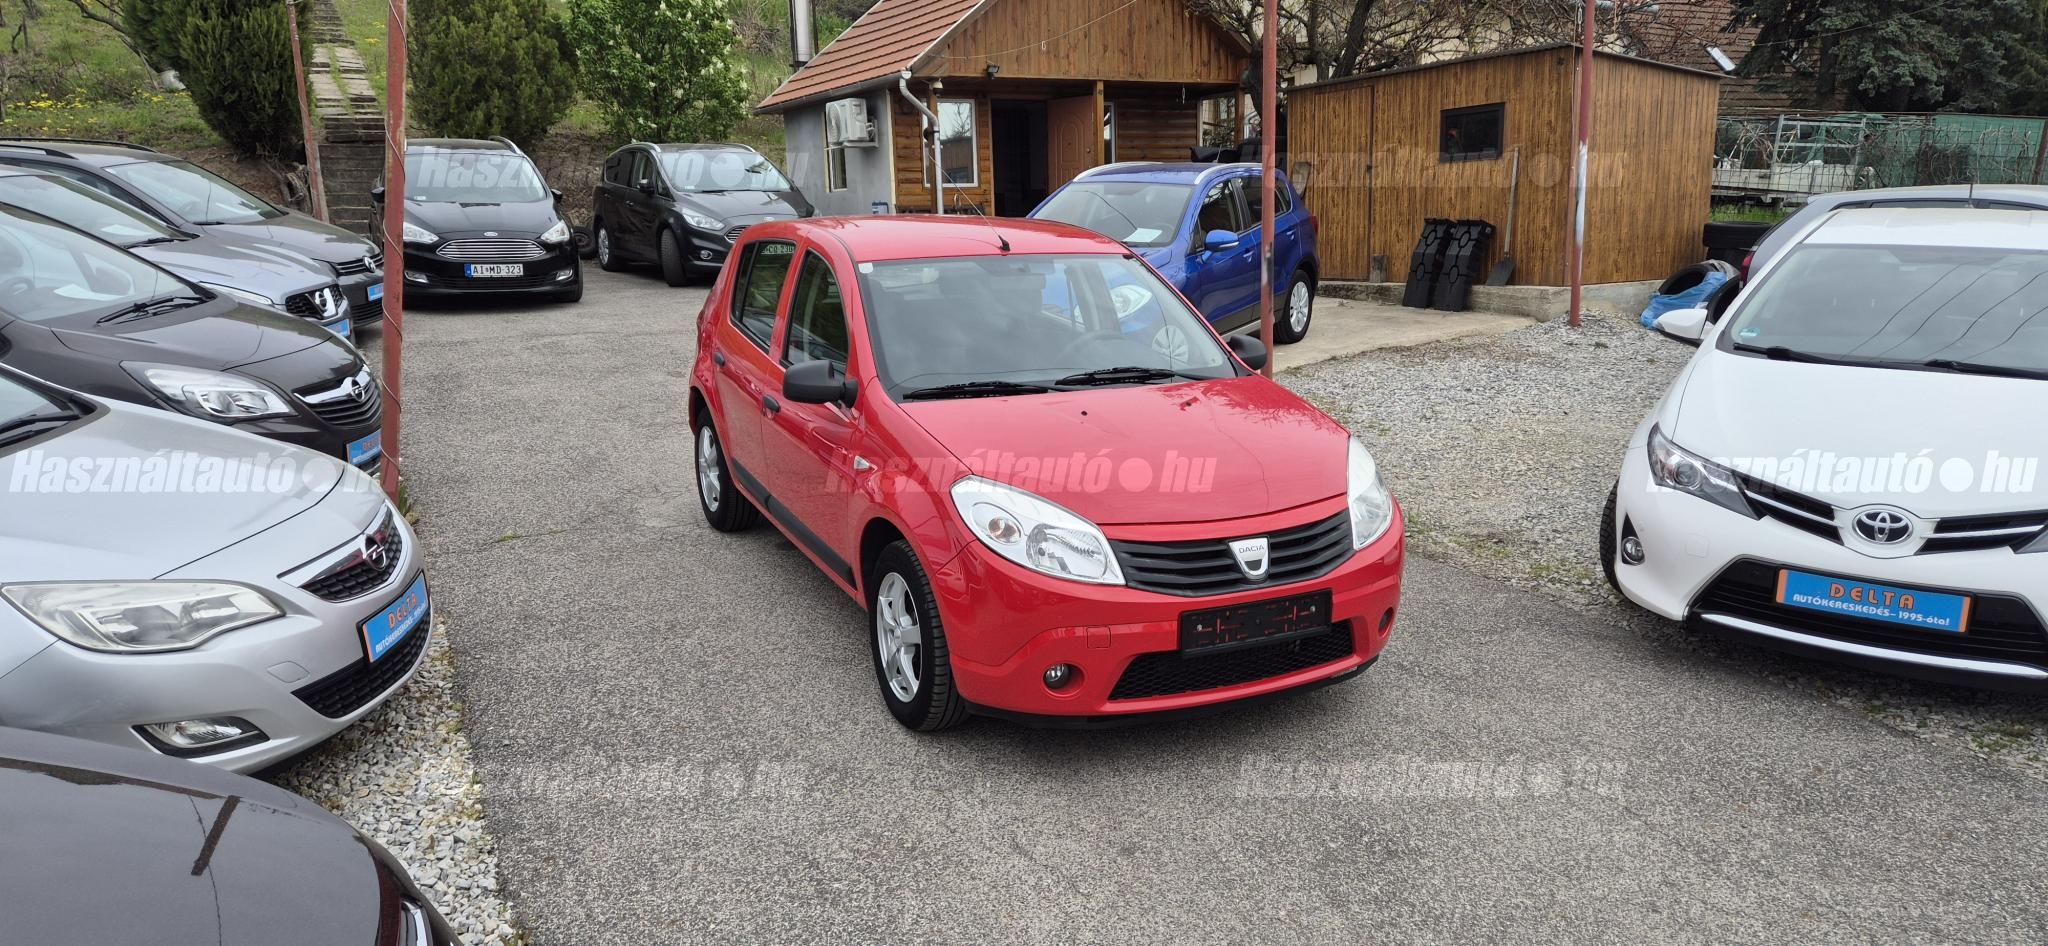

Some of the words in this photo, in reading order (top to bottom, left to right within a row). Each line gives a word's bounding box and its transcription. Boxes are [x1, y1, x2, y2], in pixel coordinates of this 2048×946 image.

[1238, 545, 1265, 554] DACIA
[1829, 583, 1915, 609] DELTA
[388, 592, 417, 629] DELTA
